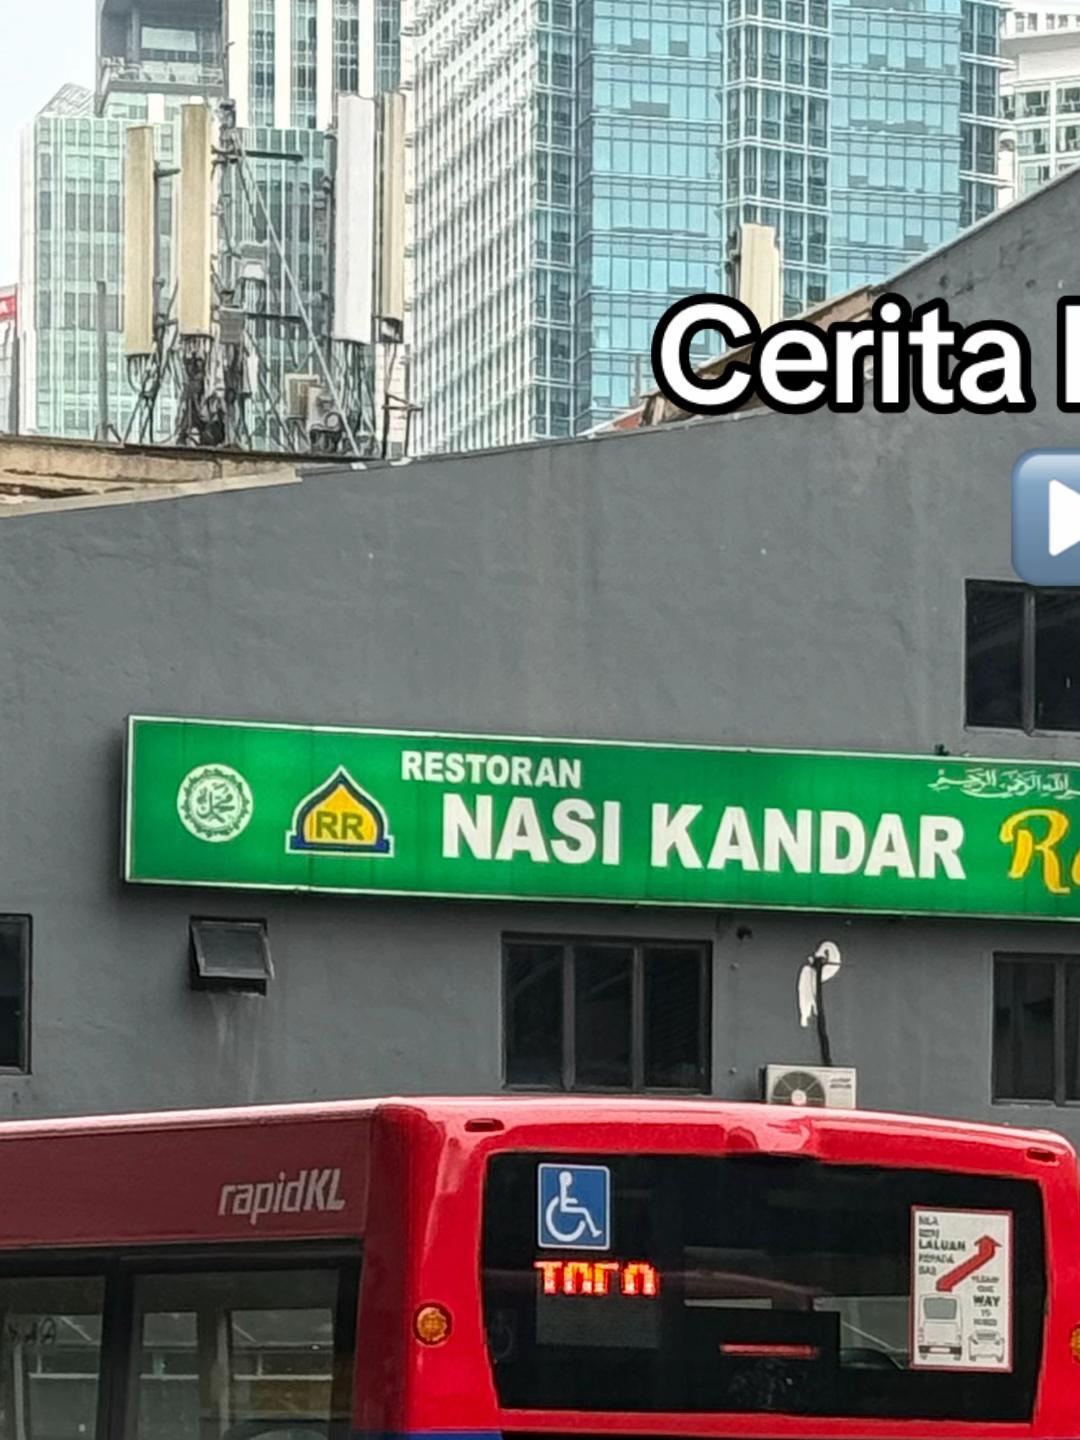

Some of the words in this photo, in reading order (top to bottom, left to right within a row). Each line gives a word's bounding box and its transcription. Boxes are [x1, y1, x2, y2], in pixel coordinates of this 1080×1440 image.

[401, 749, 582, 789] RESTORAN
[315, 810, 365, 840] RR
[442, 793, 621, 866] NASI
[650, 802, 967, 880] KANDAR
[217, 1168, 346, 1226] rapidKL
[919, 1240, 965, 1251] LALUAN
[973, 1295, 1001, 1307] WAY
